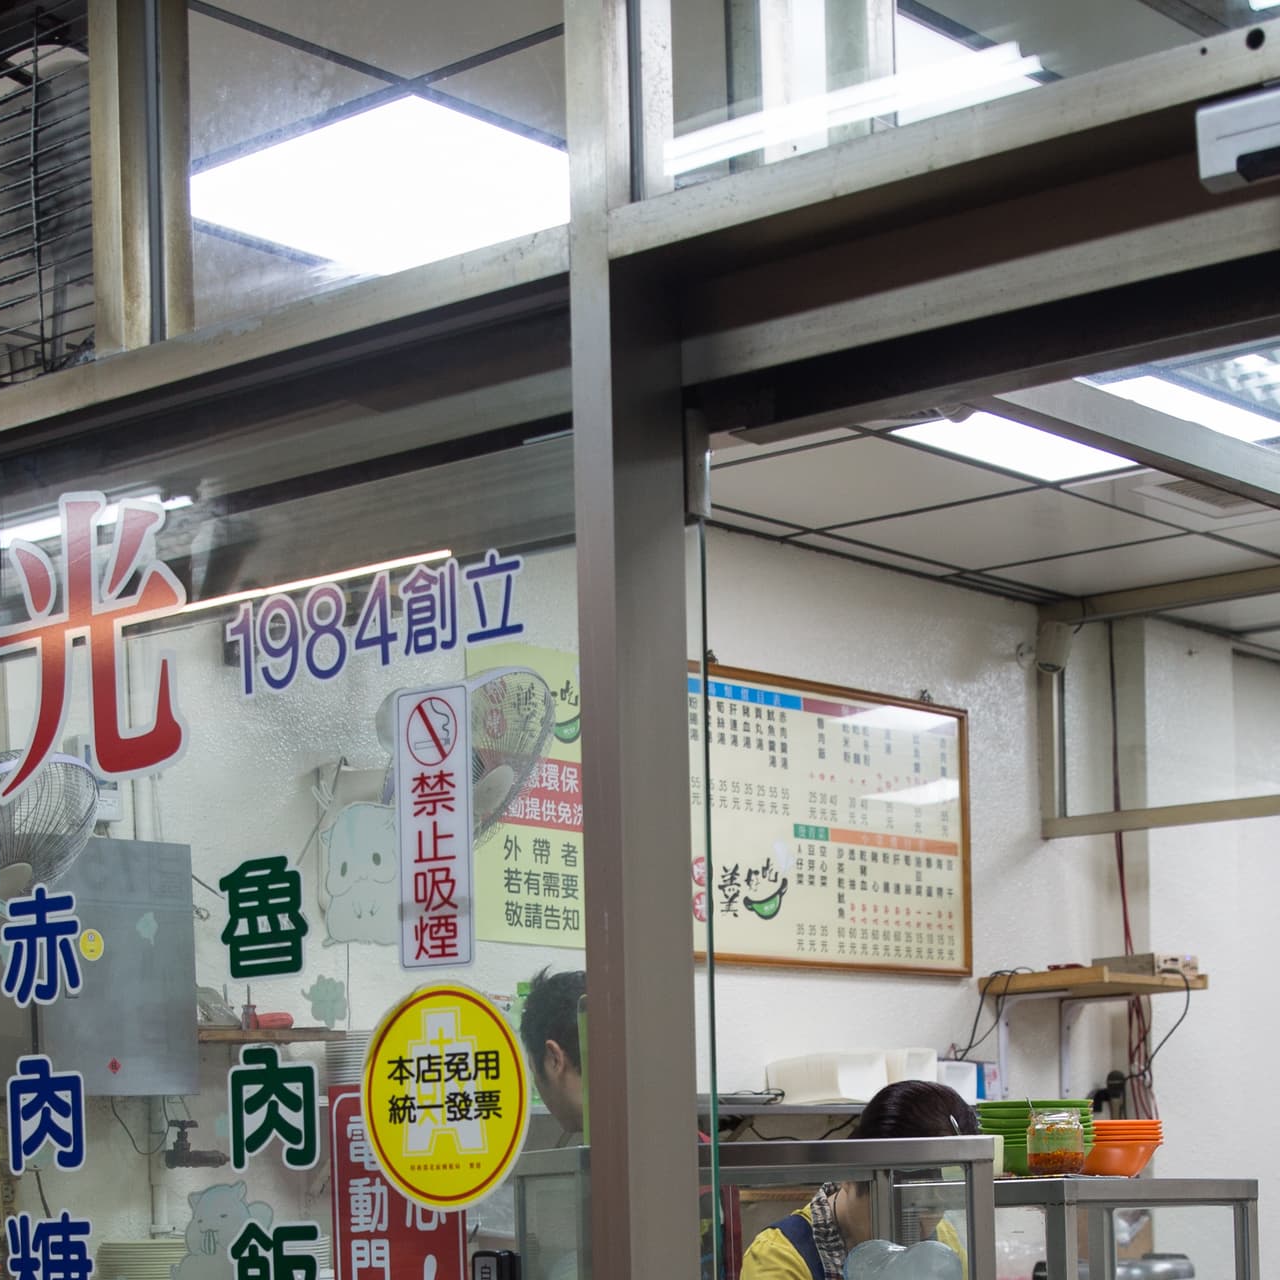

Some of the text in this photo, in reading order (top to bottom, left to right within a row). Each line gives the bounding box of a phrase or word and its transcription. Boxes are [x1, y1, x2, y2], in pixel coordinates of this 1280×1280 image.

[227, 549, 526, 695] 1984創立
[503, 796, 583, 825] 動提供免洗
[409, 769, 461, 963] 禁止吸煙
[503, 868, 580, 900] 若有需要
[504, 900, 580, 932] 敬請告知
[387, 1051, 500, 1086] 本店免用
[388, 1090, 502, 1125] 統一發票
